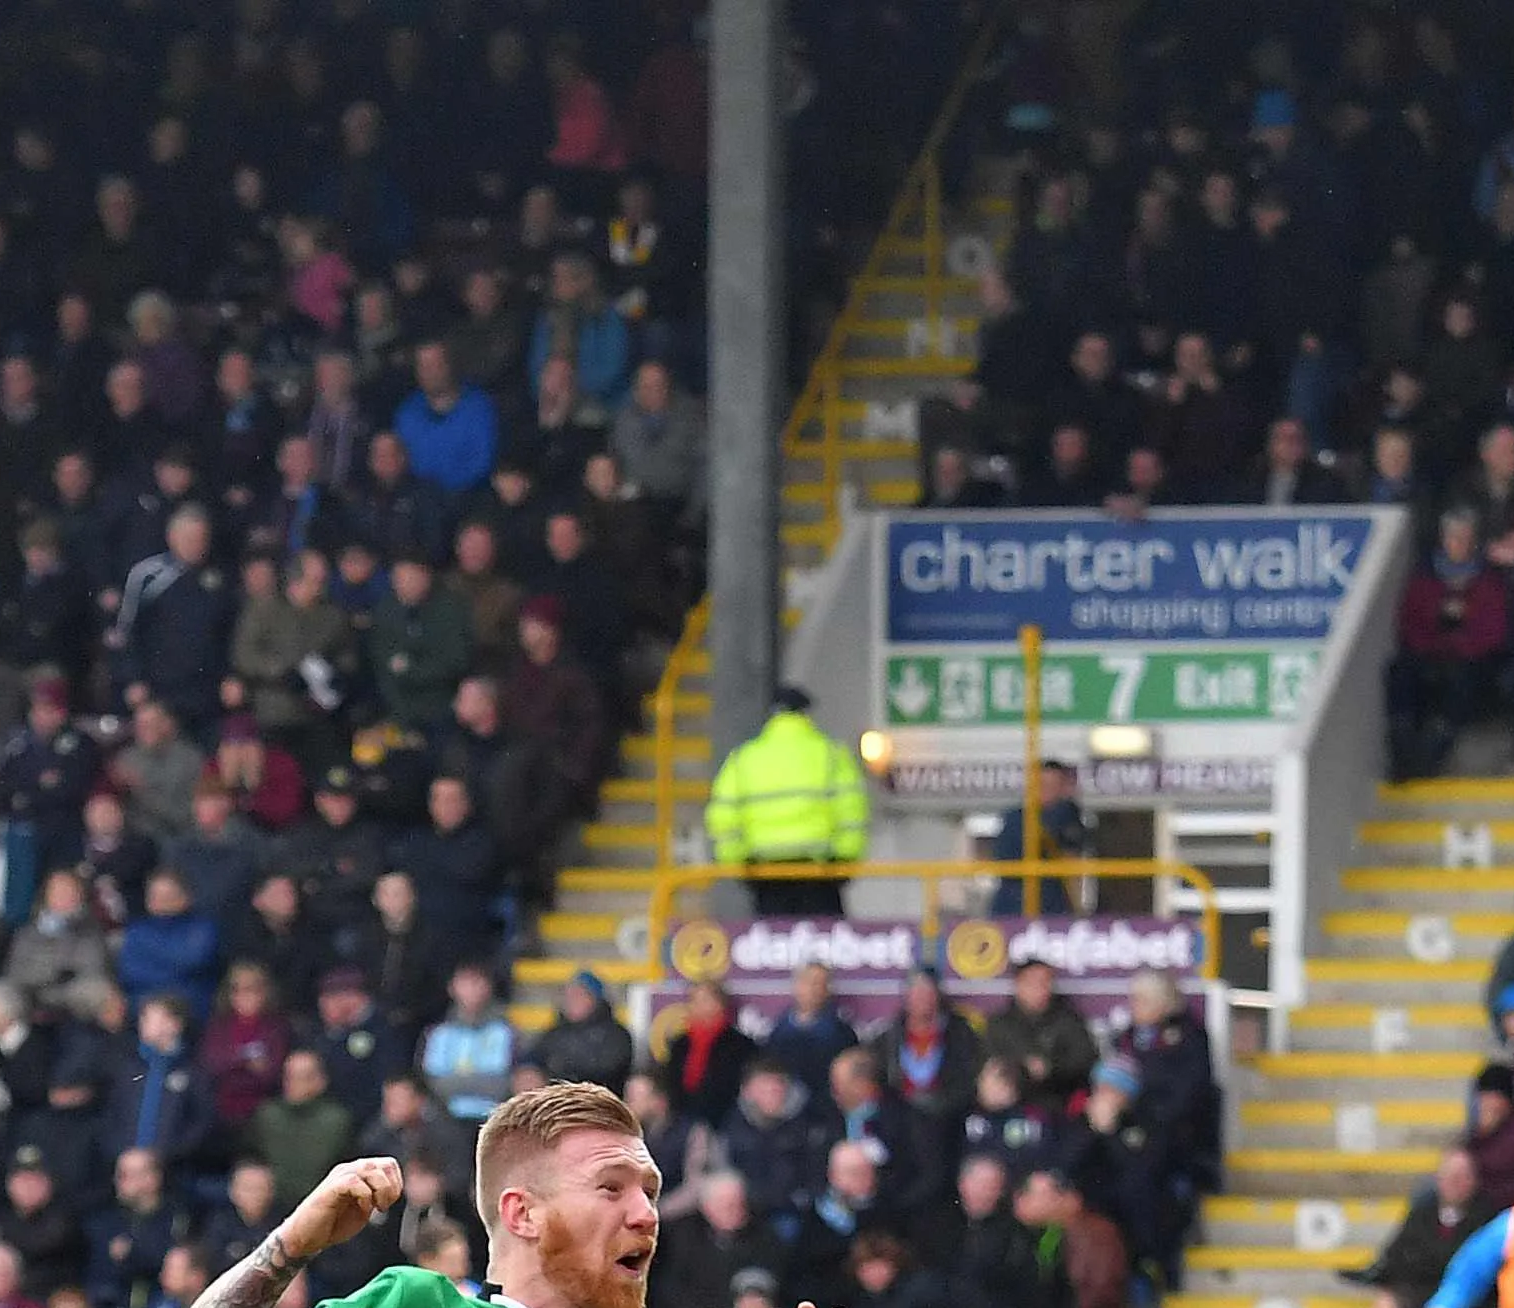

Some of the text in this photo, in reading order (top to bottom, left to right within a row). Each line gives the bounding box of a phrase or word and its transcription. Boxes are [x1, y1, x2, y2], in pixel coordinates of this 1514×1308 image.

[900, 526, 1175, 593] charter
[1192, 522, 1357, 591] walk
[1072, 597, 1230, 636] shopping
[1098, 652, 1148, 721] 7
[1174, 662, 1256, 712] Exit
[893, 761, 1026, 792] WARNIN
[1446, 821, 1492, 869] H
[731, 919, 916, 970] dafabet
[1009, 919, 1195, 976] dafabet
